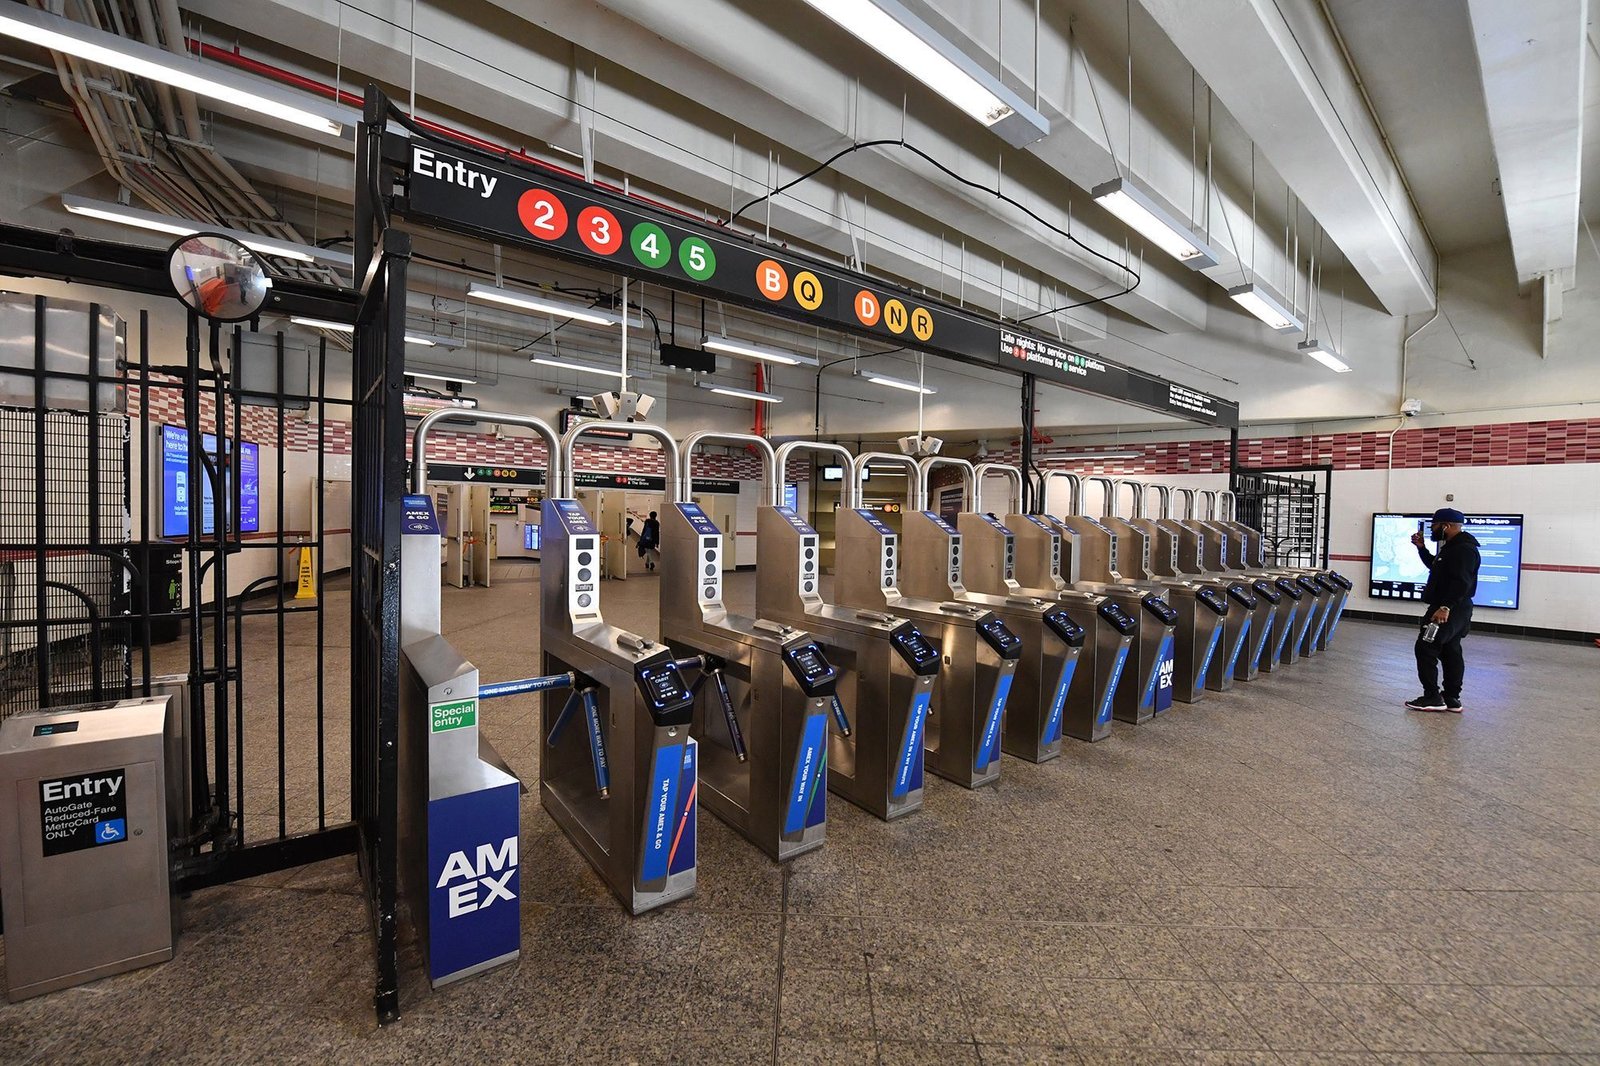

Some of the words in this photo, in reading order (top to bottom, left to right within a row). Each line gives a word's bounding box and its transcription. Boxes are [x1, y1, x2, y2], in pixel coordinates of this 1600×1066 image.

[413, 147, 497, 198] Entry
[1000, 331, 1014, 344] Late
[1016, 337, 1036, 351] nights:
[1037, 343, 1046, 353] No
[1047, 348, 1066, 360] service
[1000, 342, 1012, 354] Use
[1026, 352, 1054, 366] platforms
[1069, 364, 1086, 376] service
[166, 441, 178, 450] here
[576, 584, 593, 592] Entry
[1159, 659, 1173, 676] AM
[1160, 673, 1172, 689] EX
[434, 704, 474, 718] Special
[434, 716, 462, 727] entry
[43, 776, 123, 802] Entry
[44, 802, 92, 815] AutoGate
[45, 806, 116, 823] Reduced-Fare
[46, 816, 99, 832] MetroCard
[46, 828, 77, 840] ONLY
[655, 839, 662, 850] GO
[436, 836, 518, 888] AM
[449, 869, 517, 918] EX
